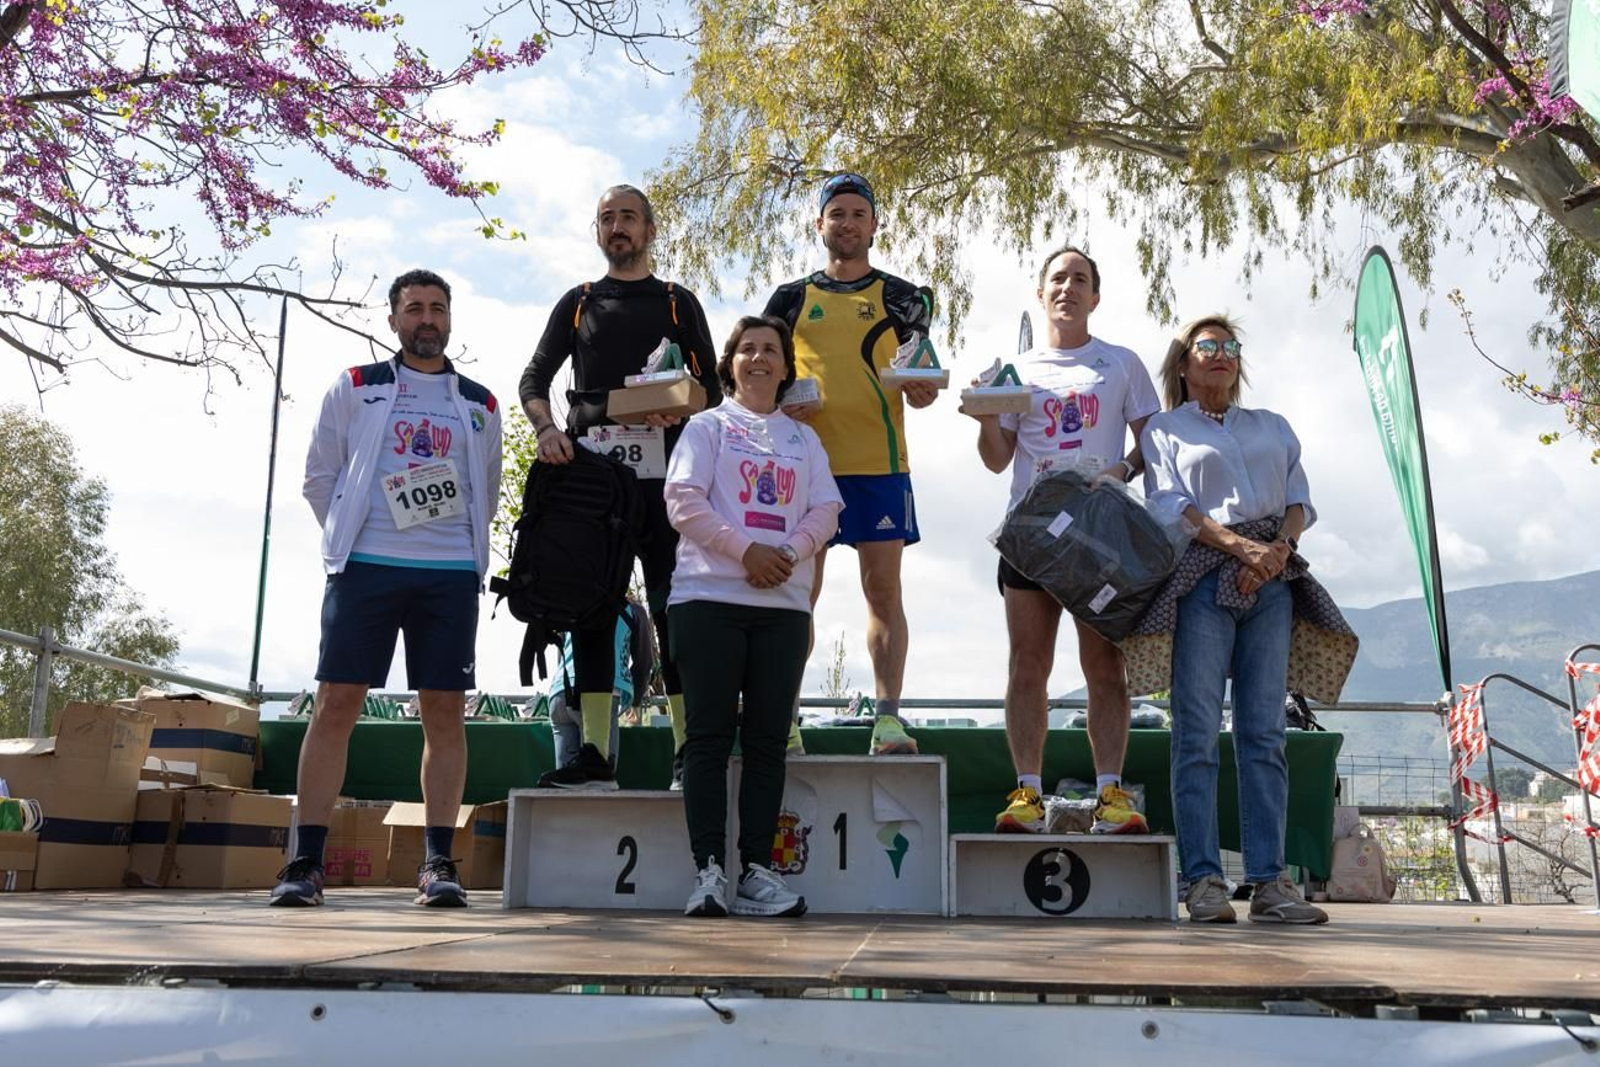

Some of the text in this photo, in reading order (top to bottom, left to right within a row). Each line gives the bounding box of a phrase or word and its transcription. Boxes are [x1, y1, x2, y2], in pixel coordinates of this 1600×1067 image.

[396, 480, 457, 511] 1098
[615, 835, 637, 894] 2
[833, 812, 847, 870] 1
[1041, 851, 1073, 912] 3
